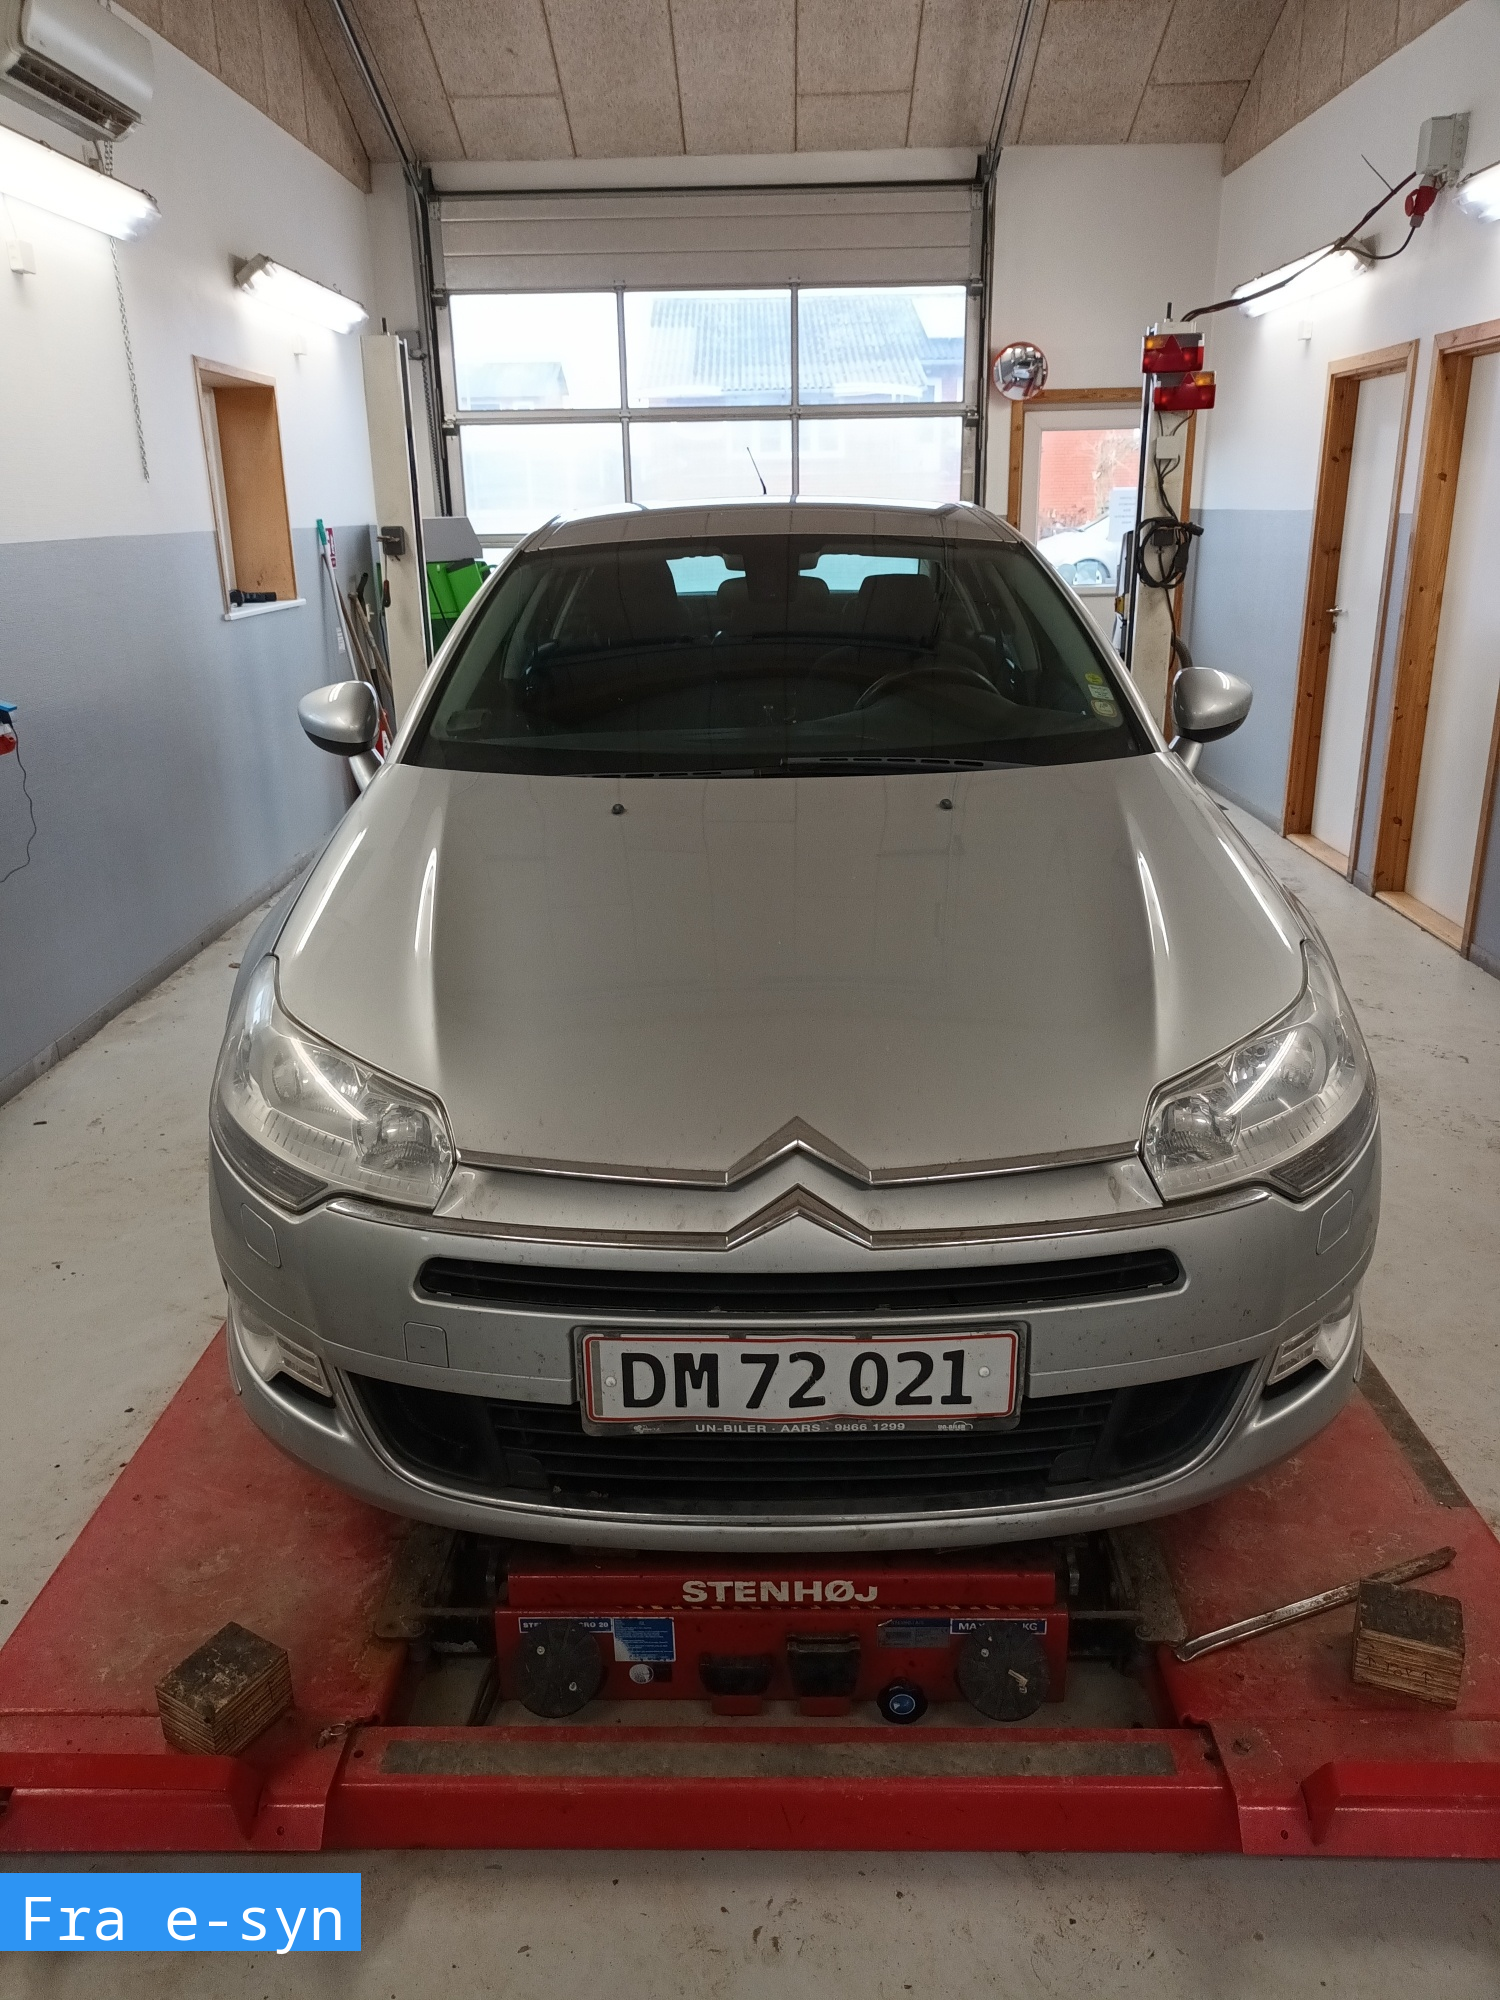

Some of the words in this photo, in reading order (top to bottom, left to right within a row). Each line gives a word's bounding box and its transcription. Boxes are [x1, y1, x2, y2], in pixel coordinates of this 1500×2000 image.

[620, 1351, 720, 1409] DM
[740, 1351, 827, 1409] 72
[848, 1349, 973, 1407] 021
[695, 1424, 767, 1433] UN-BILER
[780, 1424, 821, 1433] AARS
[834, 1423, 867, 1432] 9866
[872, 1422, 906, 1431] 1299
[682, 1579, 879, 1603] STENHØJ
[1022, 1622, 1038, 1631] KG
